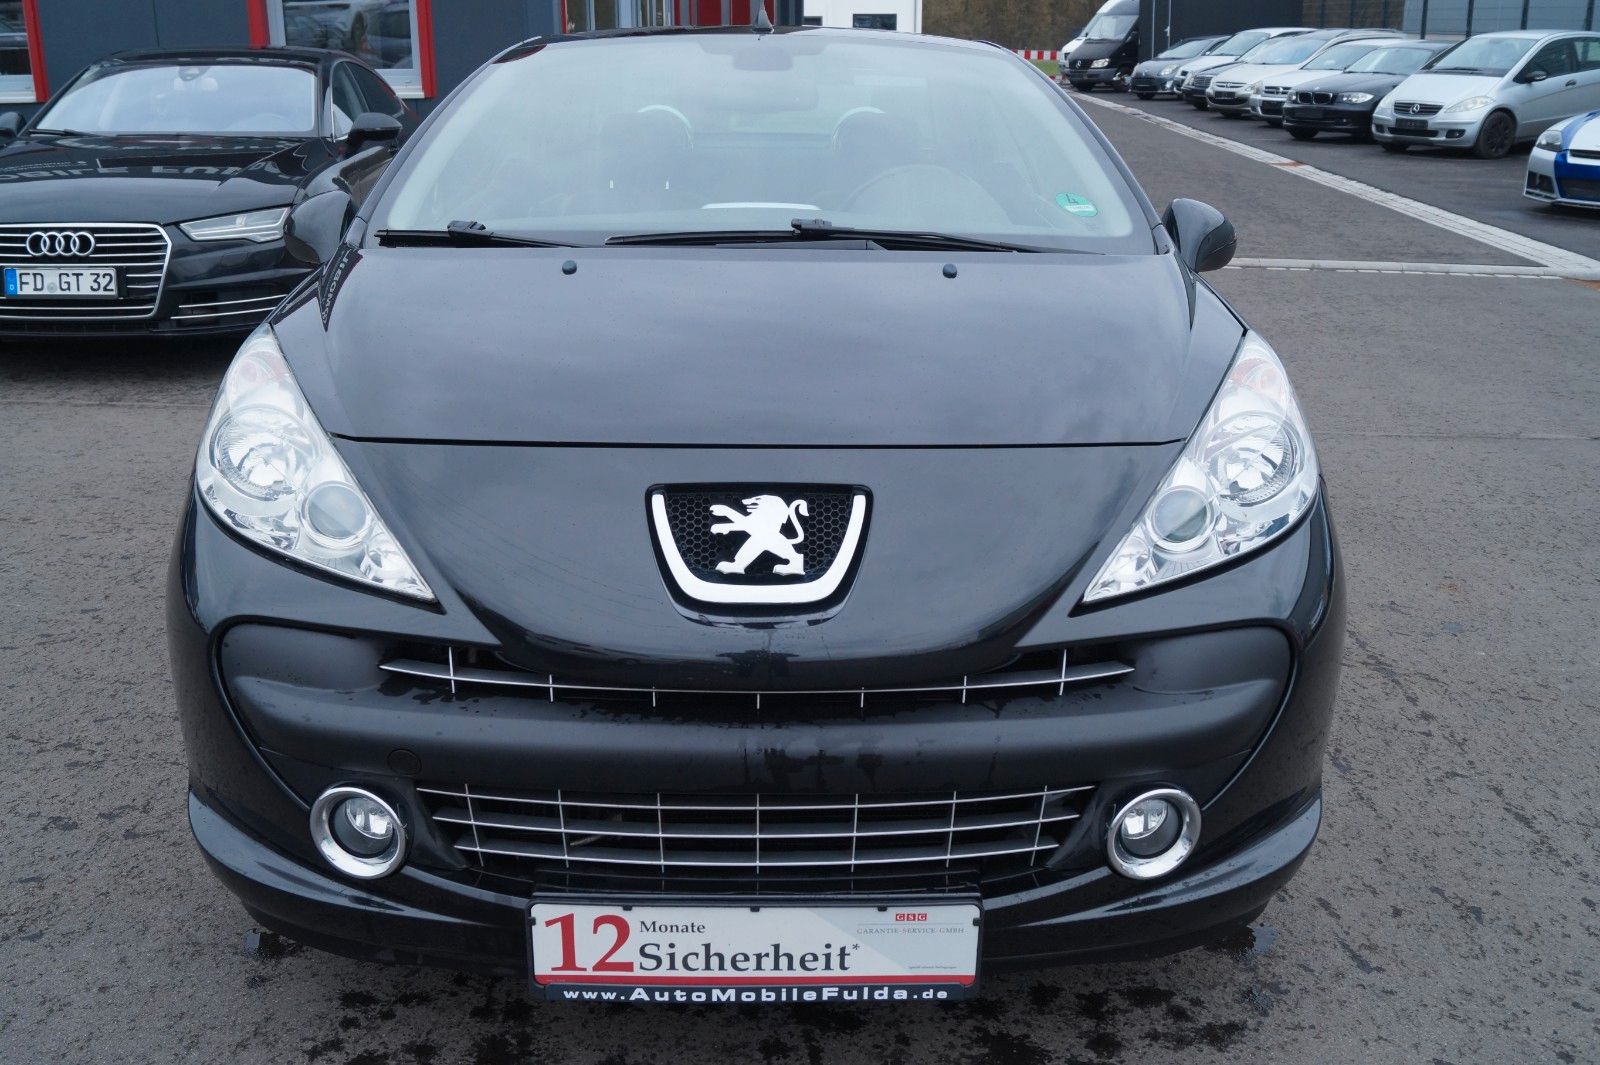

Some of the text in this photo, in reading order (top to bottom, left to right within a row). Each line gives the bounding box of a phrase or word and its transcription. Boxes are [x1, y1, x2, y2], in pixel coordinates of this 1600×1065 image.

[1066, 193, 1079, 205] 4
[18, 272, 114, 292] FD GT 32
[895, 913, 928, 922] GSG
[639, 920, 706, 934] Monate
[544, 912, 634, 972] 12
[563, 986, 948, 1002] www.AutoMobileFulda.de
